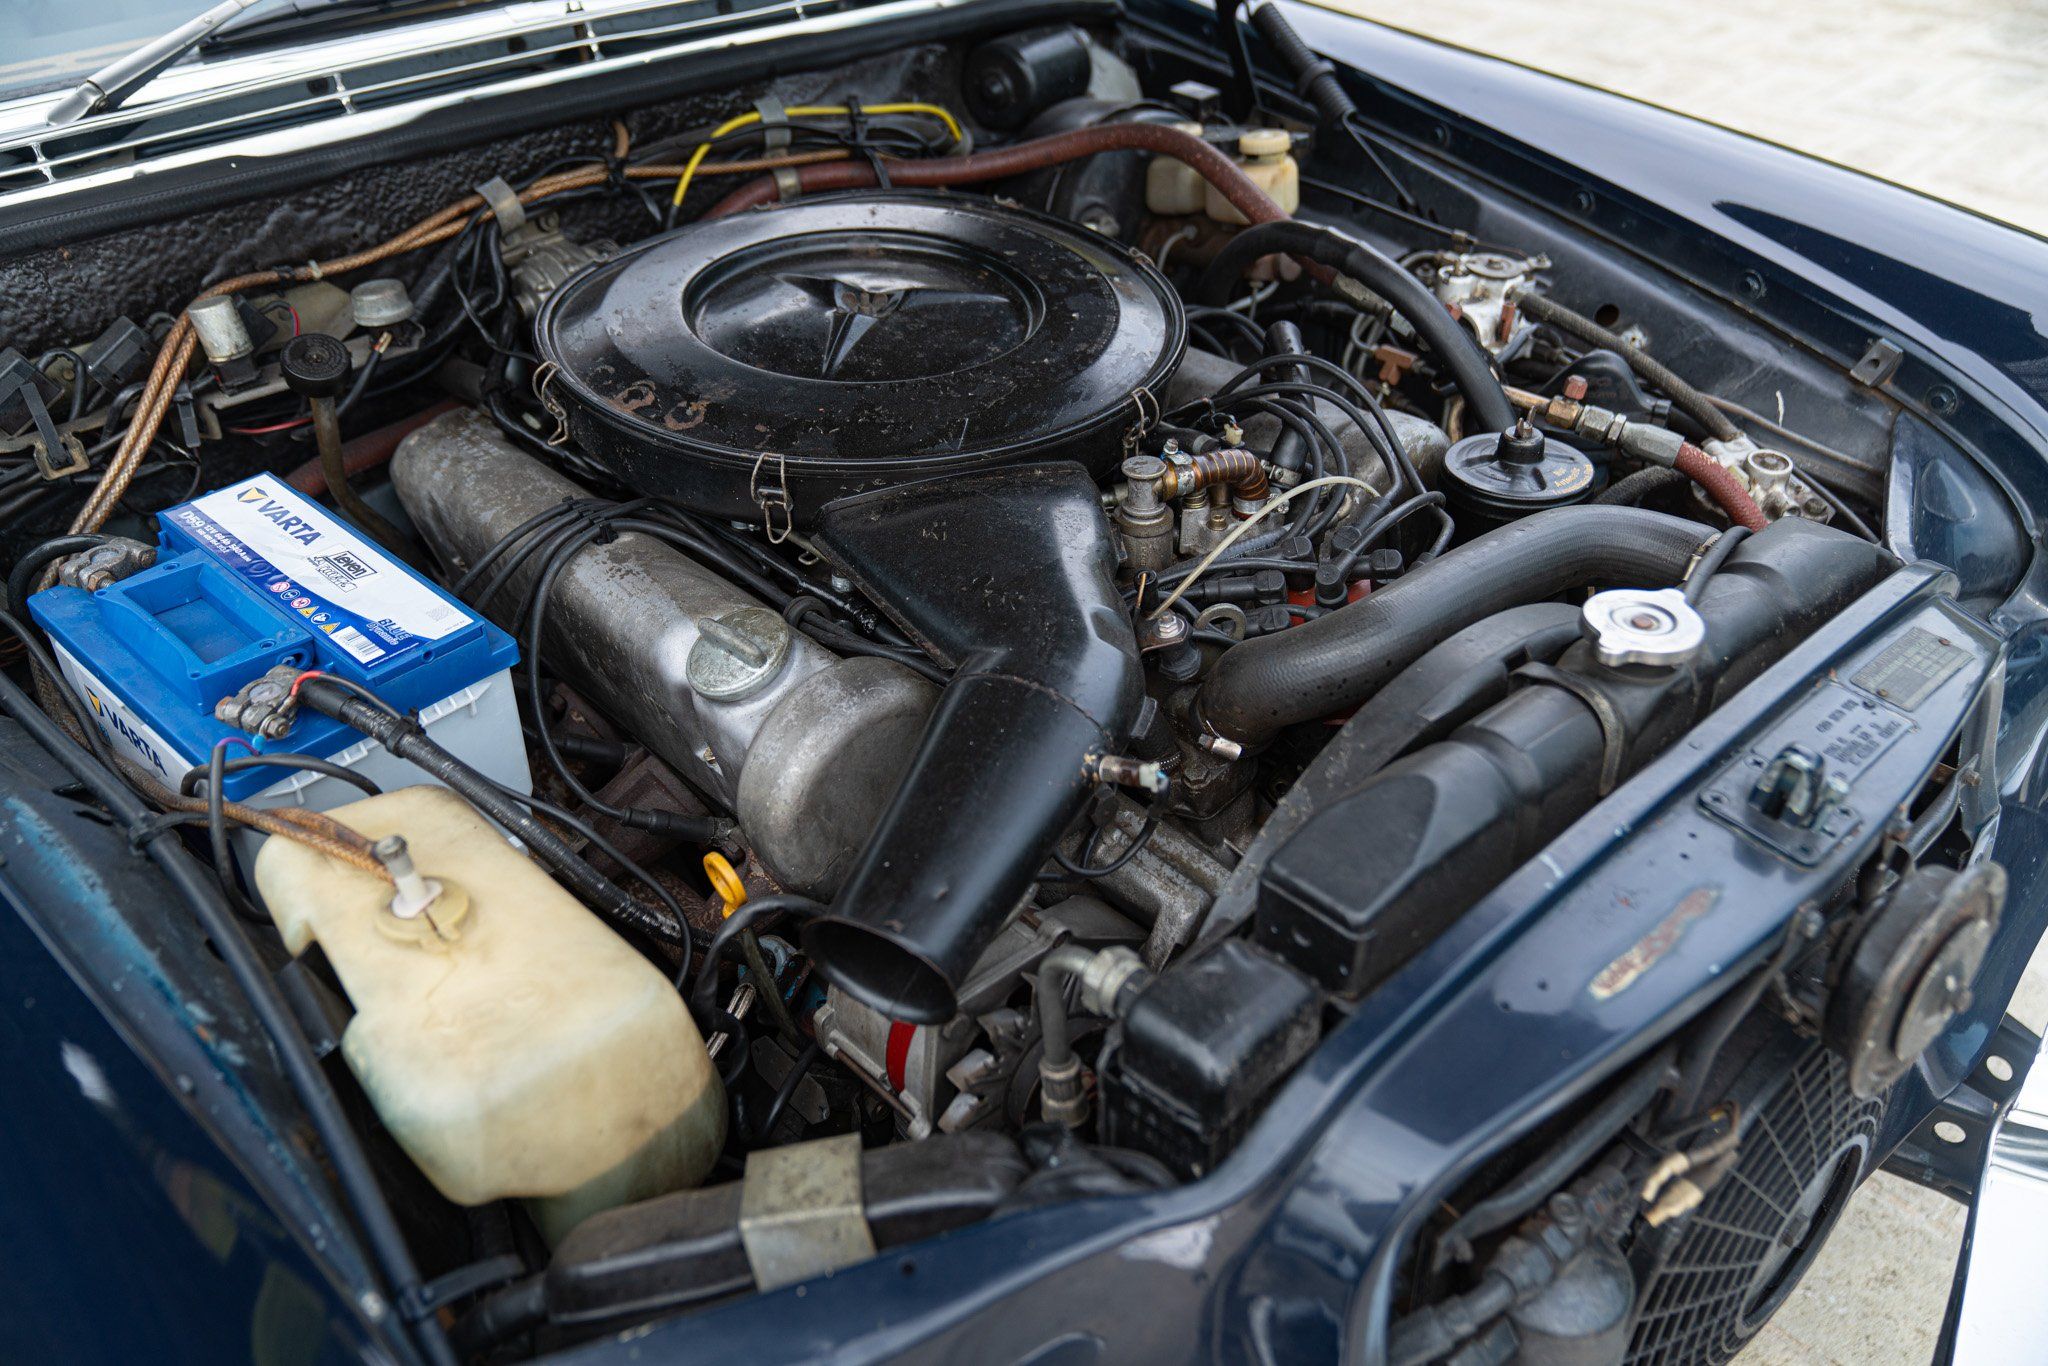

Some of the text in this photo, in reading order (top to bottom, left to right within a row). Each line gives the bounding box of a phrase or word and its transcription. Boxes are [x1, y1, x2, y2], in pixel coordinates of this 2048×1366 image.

[179, 510, 206, 528] D59
[257, 499, 322, 546] VARTA
[366, 622, 399, 646] Dynamic
[378, 618, 414, 641] BLUE
[102, 702, 168, 777] VARTA
